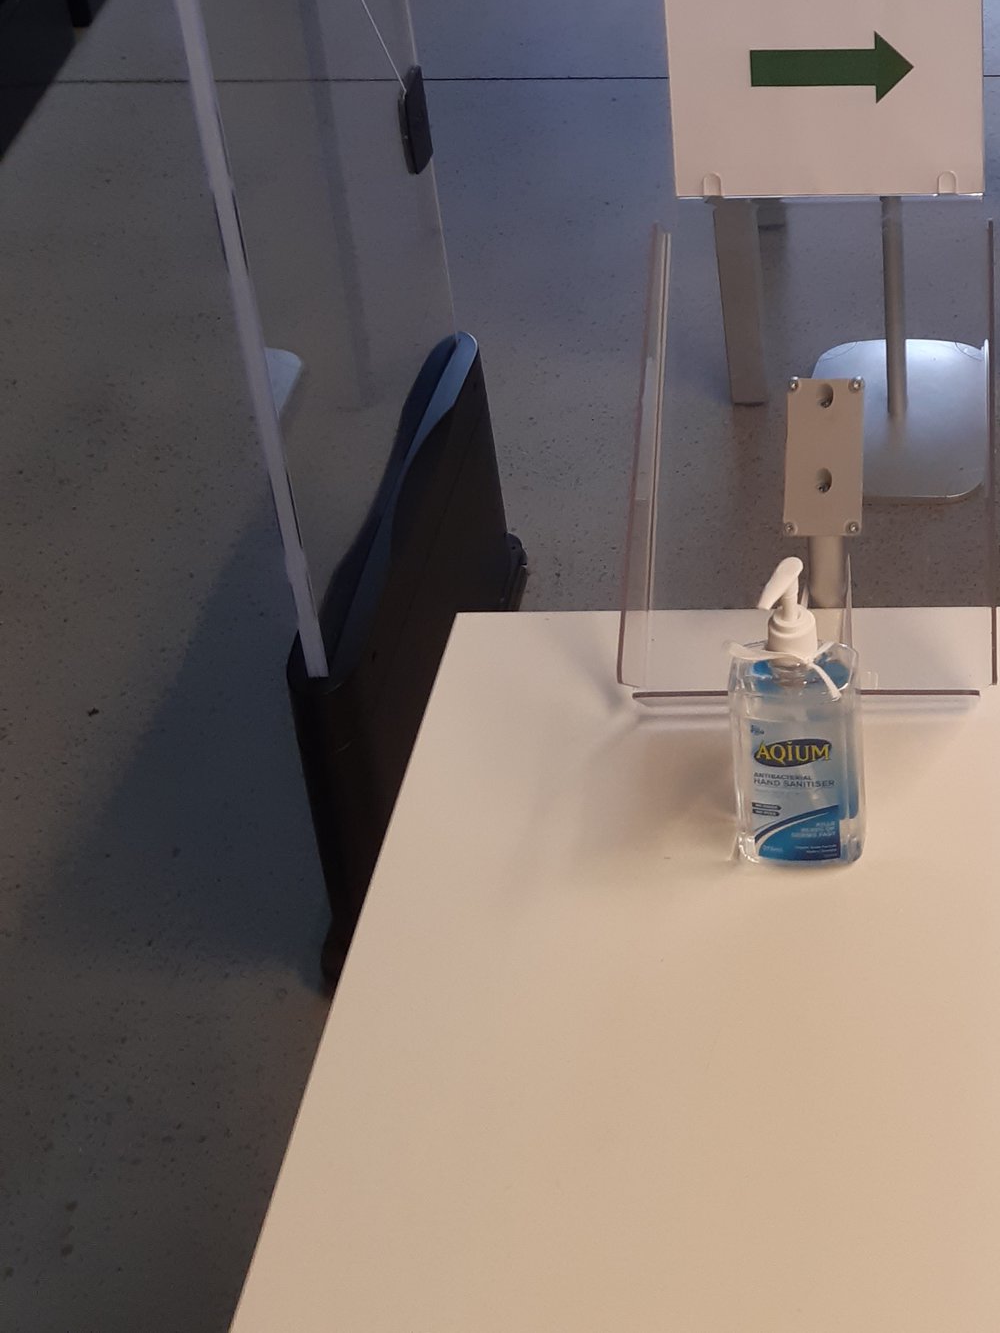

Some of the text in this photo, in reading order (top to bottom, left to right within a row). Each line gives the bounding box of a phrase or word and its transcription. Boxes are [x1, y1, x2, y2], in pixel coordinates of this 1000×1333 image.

[755, 740, 832, 765] AQIUM
[753, 771, 812, 781] ANTIBACTERIAL
[753, 779, 835, 789] HAND SANITISER
